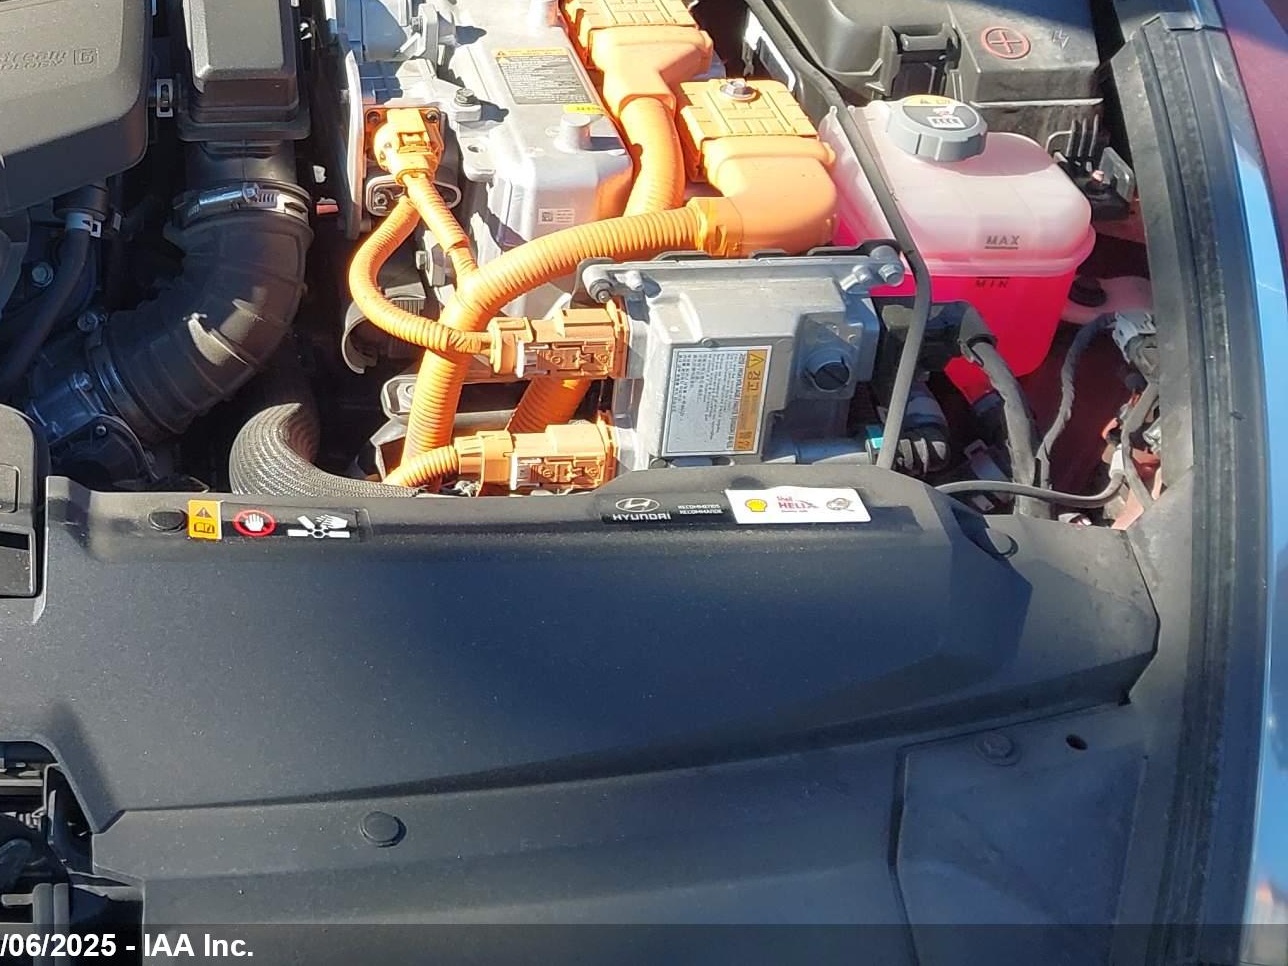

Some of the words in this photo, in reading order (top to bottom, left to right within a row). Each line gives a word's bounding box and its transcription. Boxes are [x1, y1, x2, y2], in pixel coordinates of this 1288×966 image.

[985, 235, 1020, 245] MAX
[975, 279, 1008, 289] MIN
[612, 513, 672, 521] HYUNDAI
